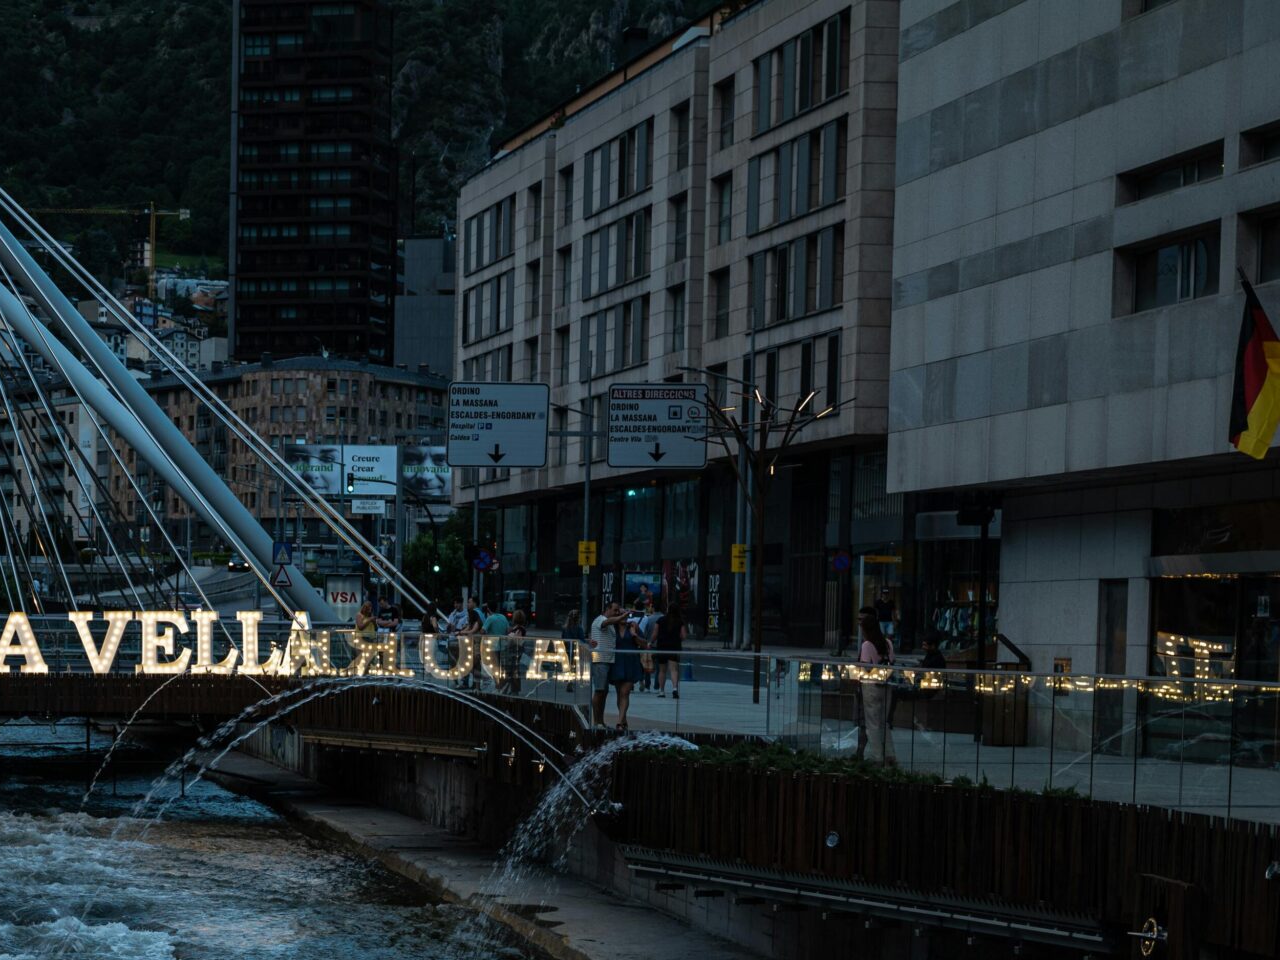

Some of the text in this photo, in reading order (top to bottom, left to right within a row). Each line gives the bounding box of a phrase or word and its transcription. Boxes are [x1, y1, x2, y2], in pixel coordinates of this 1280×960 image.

[451, 387, 481, 395] ORDINO
[613, 389, 695, 399] ALTRES DIRECCIONS
[451, 399, 498, 407] LA MASSANA
[610, 403, 639, 411] ORDINO
[450, 411, 536, 420] ESCALDES-ENGORDANY
[610, 414, 657, 422] LA MASSANA
[351, 454, 380, 463] Creure
[351, 464, 375, 472] Crear
[402, 463, 450, 473] Innovand
[708, 593, 720, 611] LEX
[67, 609, 322, 677] VELLA
